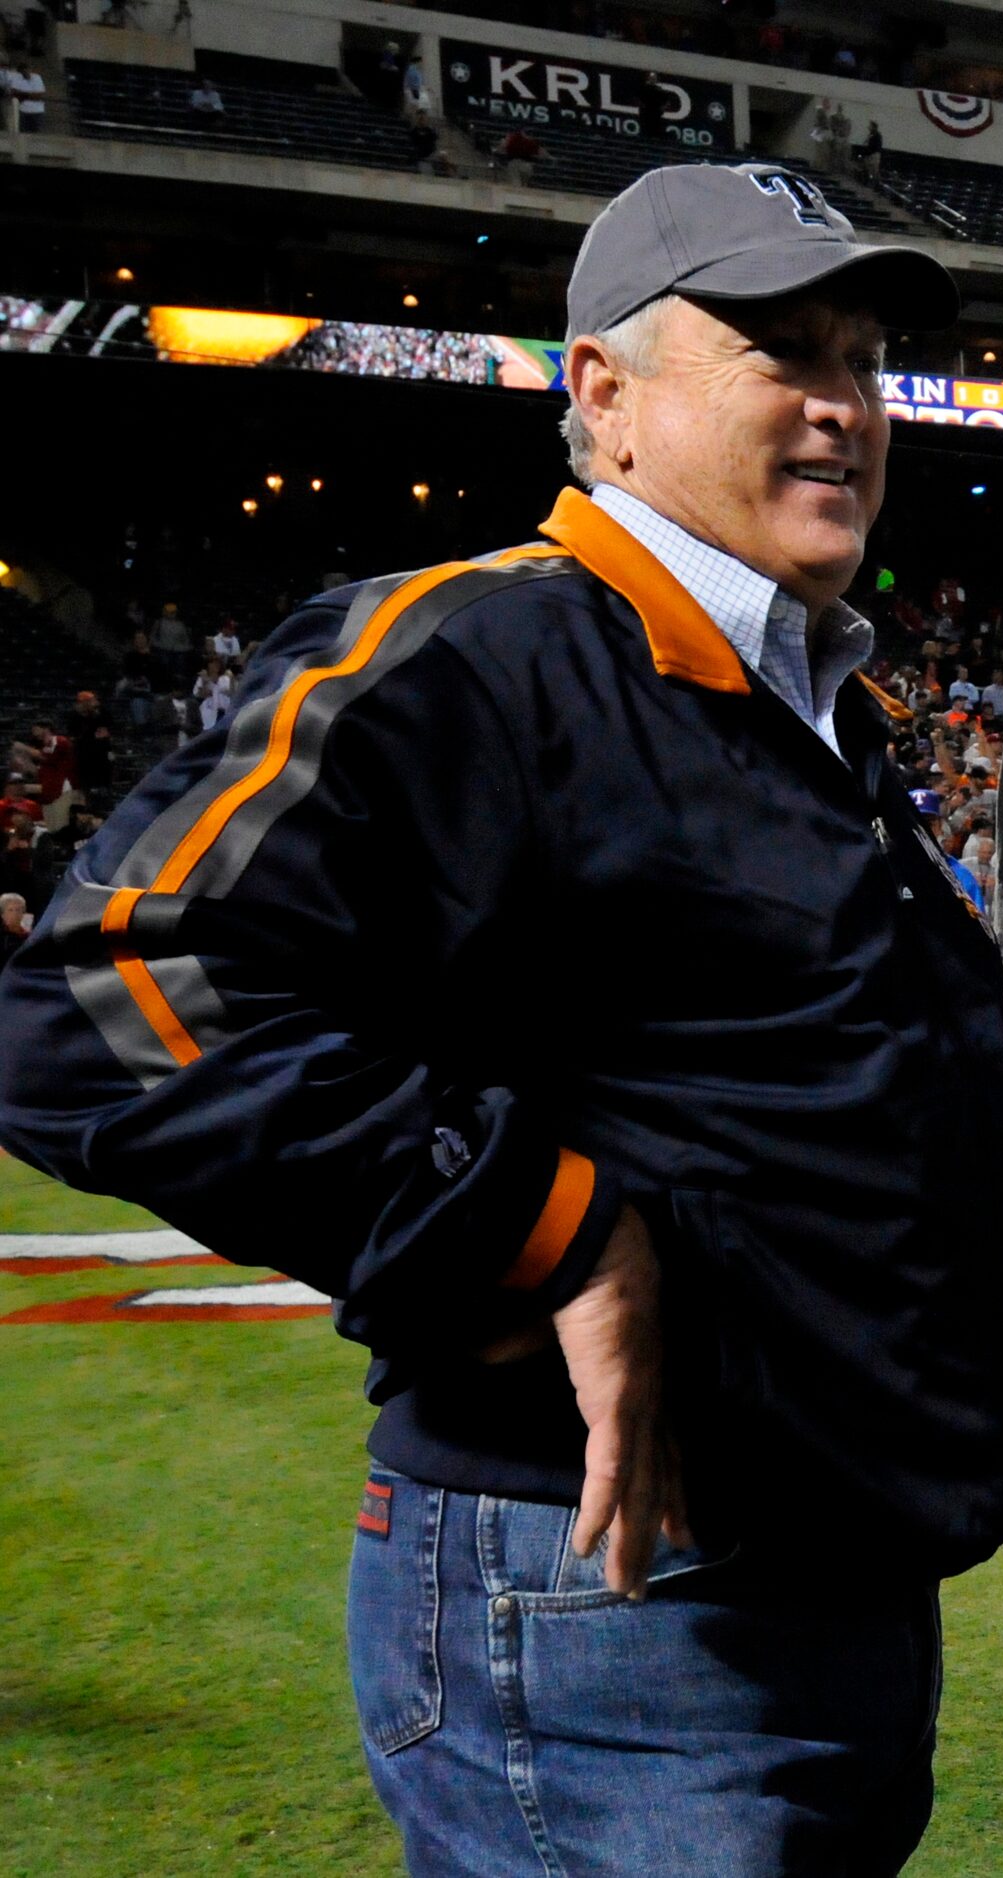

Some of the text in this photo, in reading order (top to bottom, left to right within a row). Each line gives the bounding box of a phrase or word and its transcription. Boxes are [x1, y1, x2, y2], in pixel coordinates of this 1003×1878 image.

[488, 56, 692, 121] KRLD
[912, 376, 947, 404] IN
[912, 791, 927, 805] T
